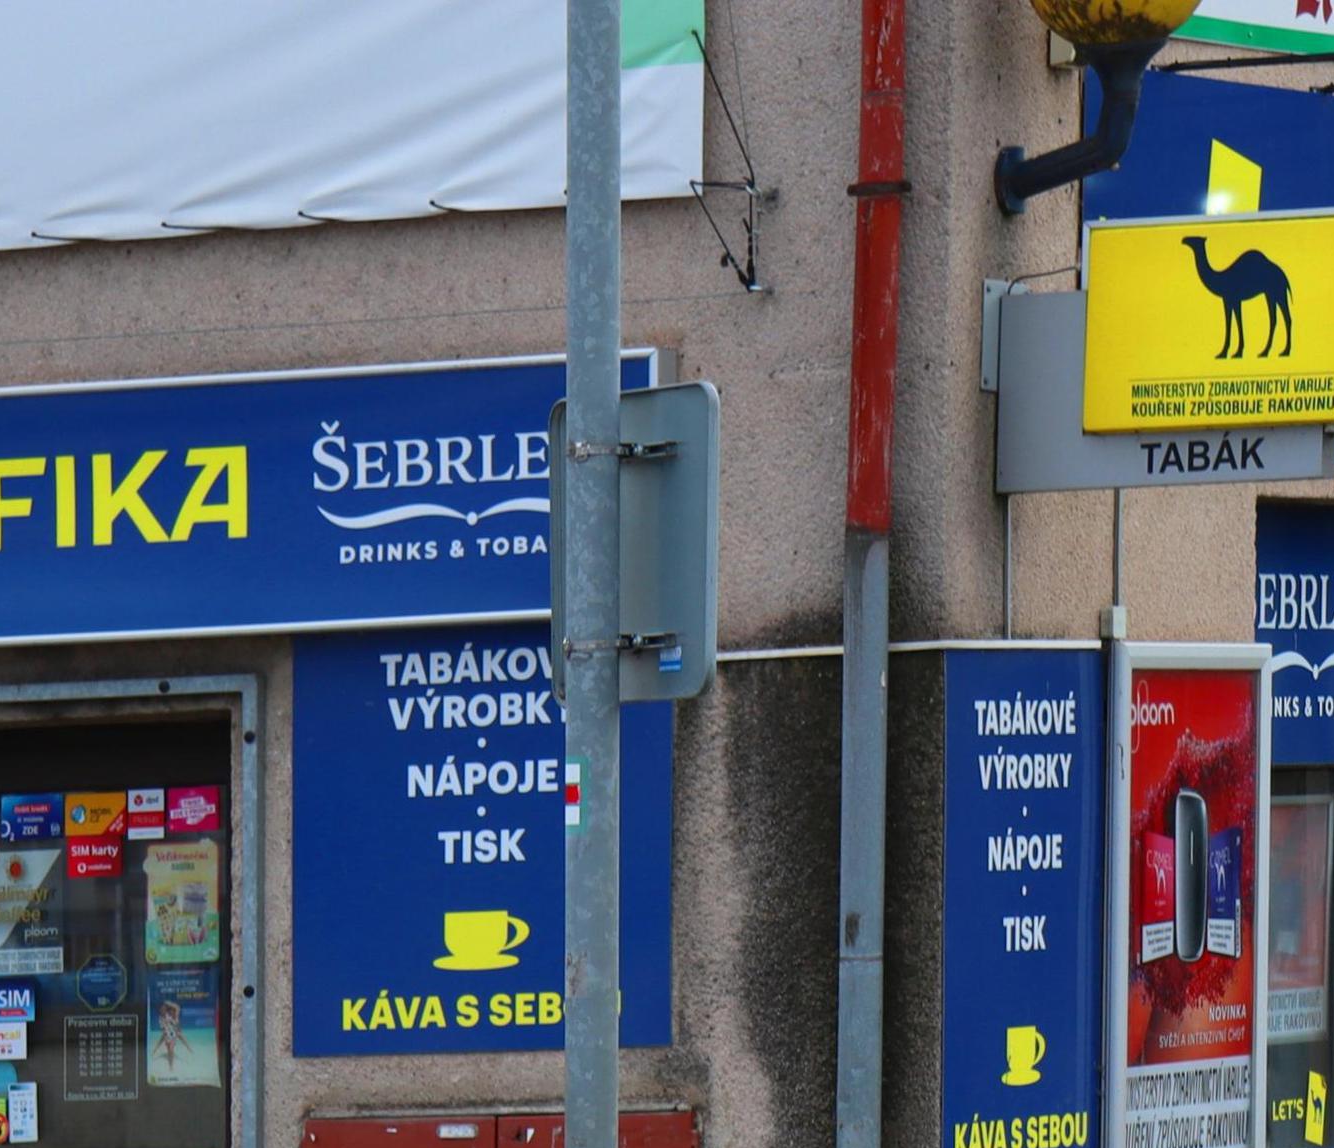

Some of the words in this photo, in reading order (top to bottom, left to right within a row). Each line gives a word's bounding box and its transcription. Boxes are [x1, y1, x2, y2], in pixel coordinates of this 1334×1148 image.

[1131, 381, 1205, 399] MINISTERSTVO
[1208, 376, 1290, 397] ZDRAVOTNICTVÍ
[1131, 398, 1186, 417] KOUŘENÍ
[1189, 397, 1264, 416] ZPŮSOBUJE
[312, 419, 551, 493] ŠEBRLE
[1140, 430, 1266, 475] TABÁK
[339, 541, 439, 566] DRINKS
[449, 539, 466, 559] &
[476, 535, 549, 557] TOBA
[380, 642, 552, 687] TABÁKOV
[388, 688, 566, 731] VÝROBK
[974, 691, 1076, 736] TABÁKOVÉ
[1272, 695, 1300, 718] NKS
[1304, 695, 1313, 718] &
[407, 755, 559, 799] NÁPOJE
[978, 746, 1072, 790] VÝROBKY
[22, 825, 38, 836] ZDE
[438, 828, 527, 864] TISK
[71, 845, 90, 857] SIM
[92, 844, 119, 859] karty
[987, 827, 1063, 872] NÁPOJE
[24, 924, 59, 943] ploom
[1003, 915, 1047, 952] TISK
[342, 989, 447, 1031] KÁVA
[455, 994, 480, 1028] S
[489, 989, 621, 1026] SEB
[1208, 1003, 1247, 1022] NOVINKA
[1272, 1098, 1304, 1121] LET'S
[1207, 1110, 1250, 1148] RAKOVINU
